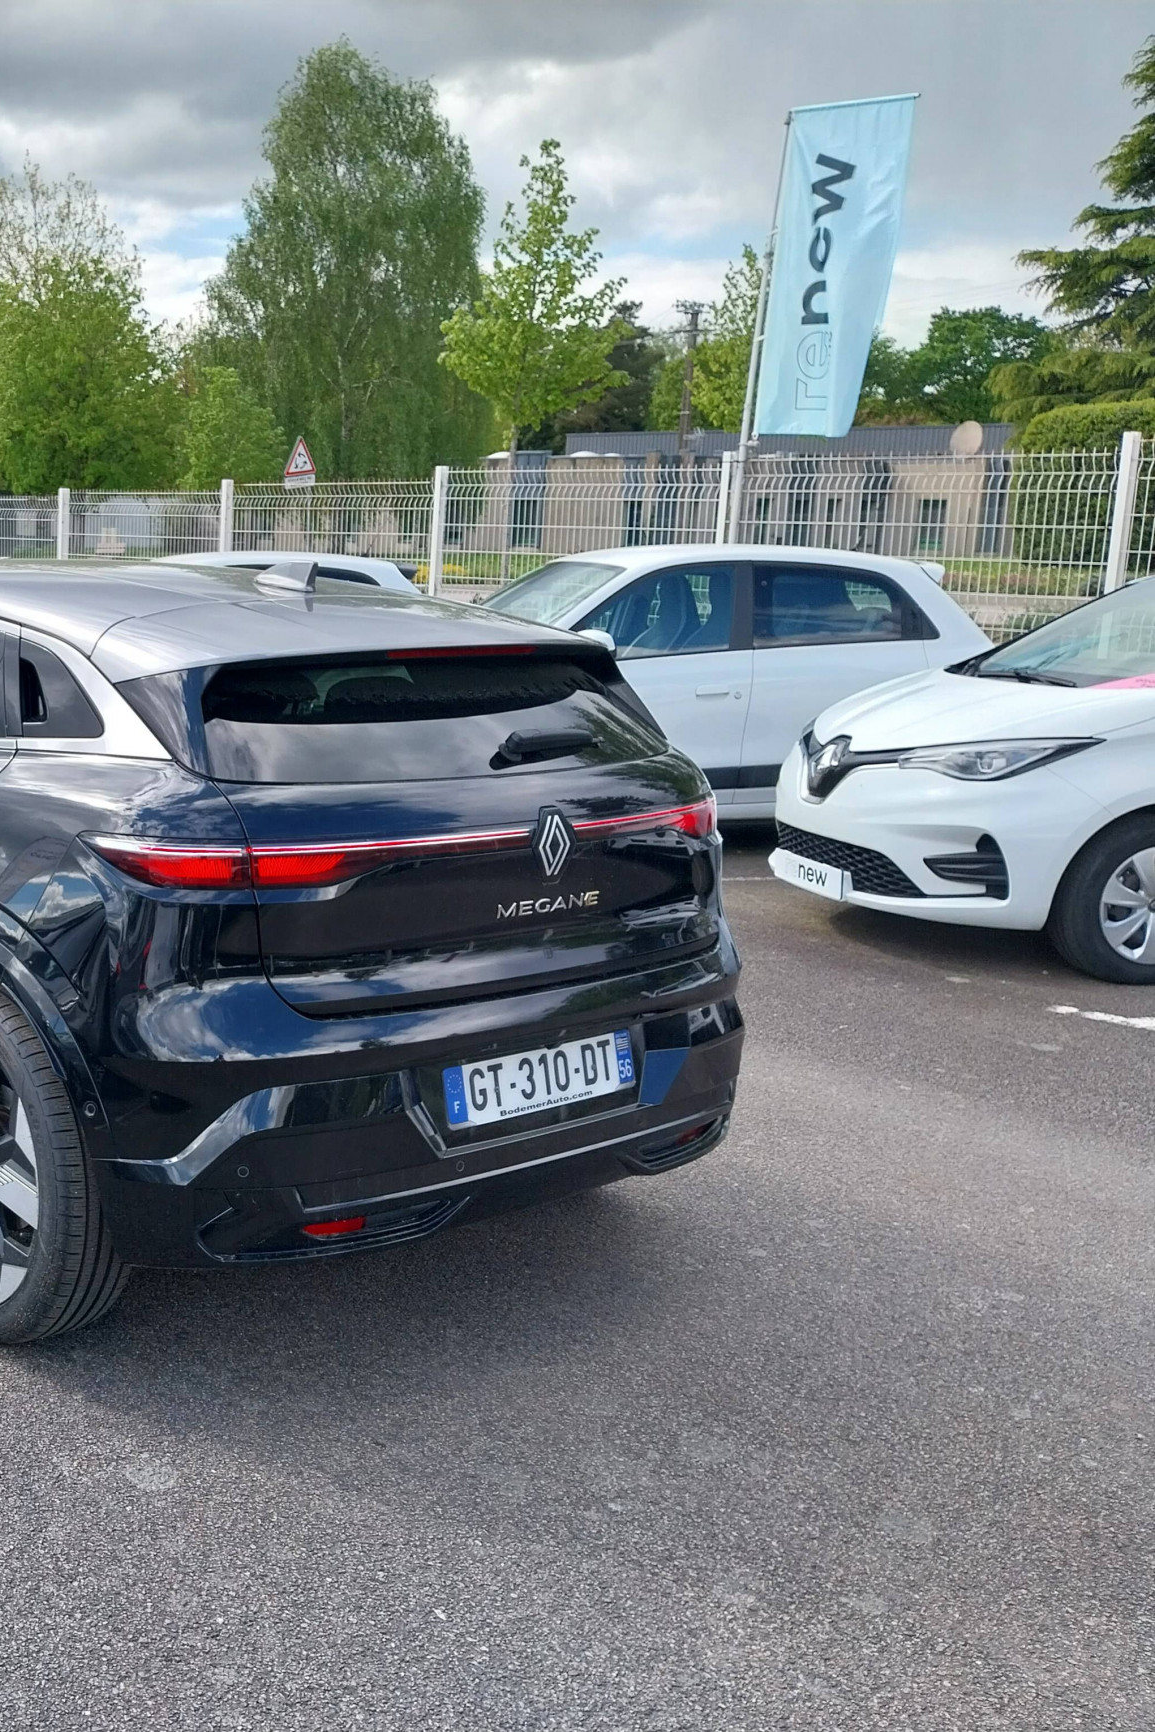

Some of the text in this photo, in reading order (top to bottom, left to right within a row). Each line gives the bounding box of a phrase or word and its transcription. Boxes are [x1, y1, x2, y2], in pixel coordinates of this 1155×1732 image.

[496, 890, 600, 919] MEGANE
[468, 1038, 611, 1111] GT-310-DT
[618, 1058, 633, 1079] 56
[453, 1101, 461, 1114] F
[499, 1089, 593, 1117] BodemerAuto.com
